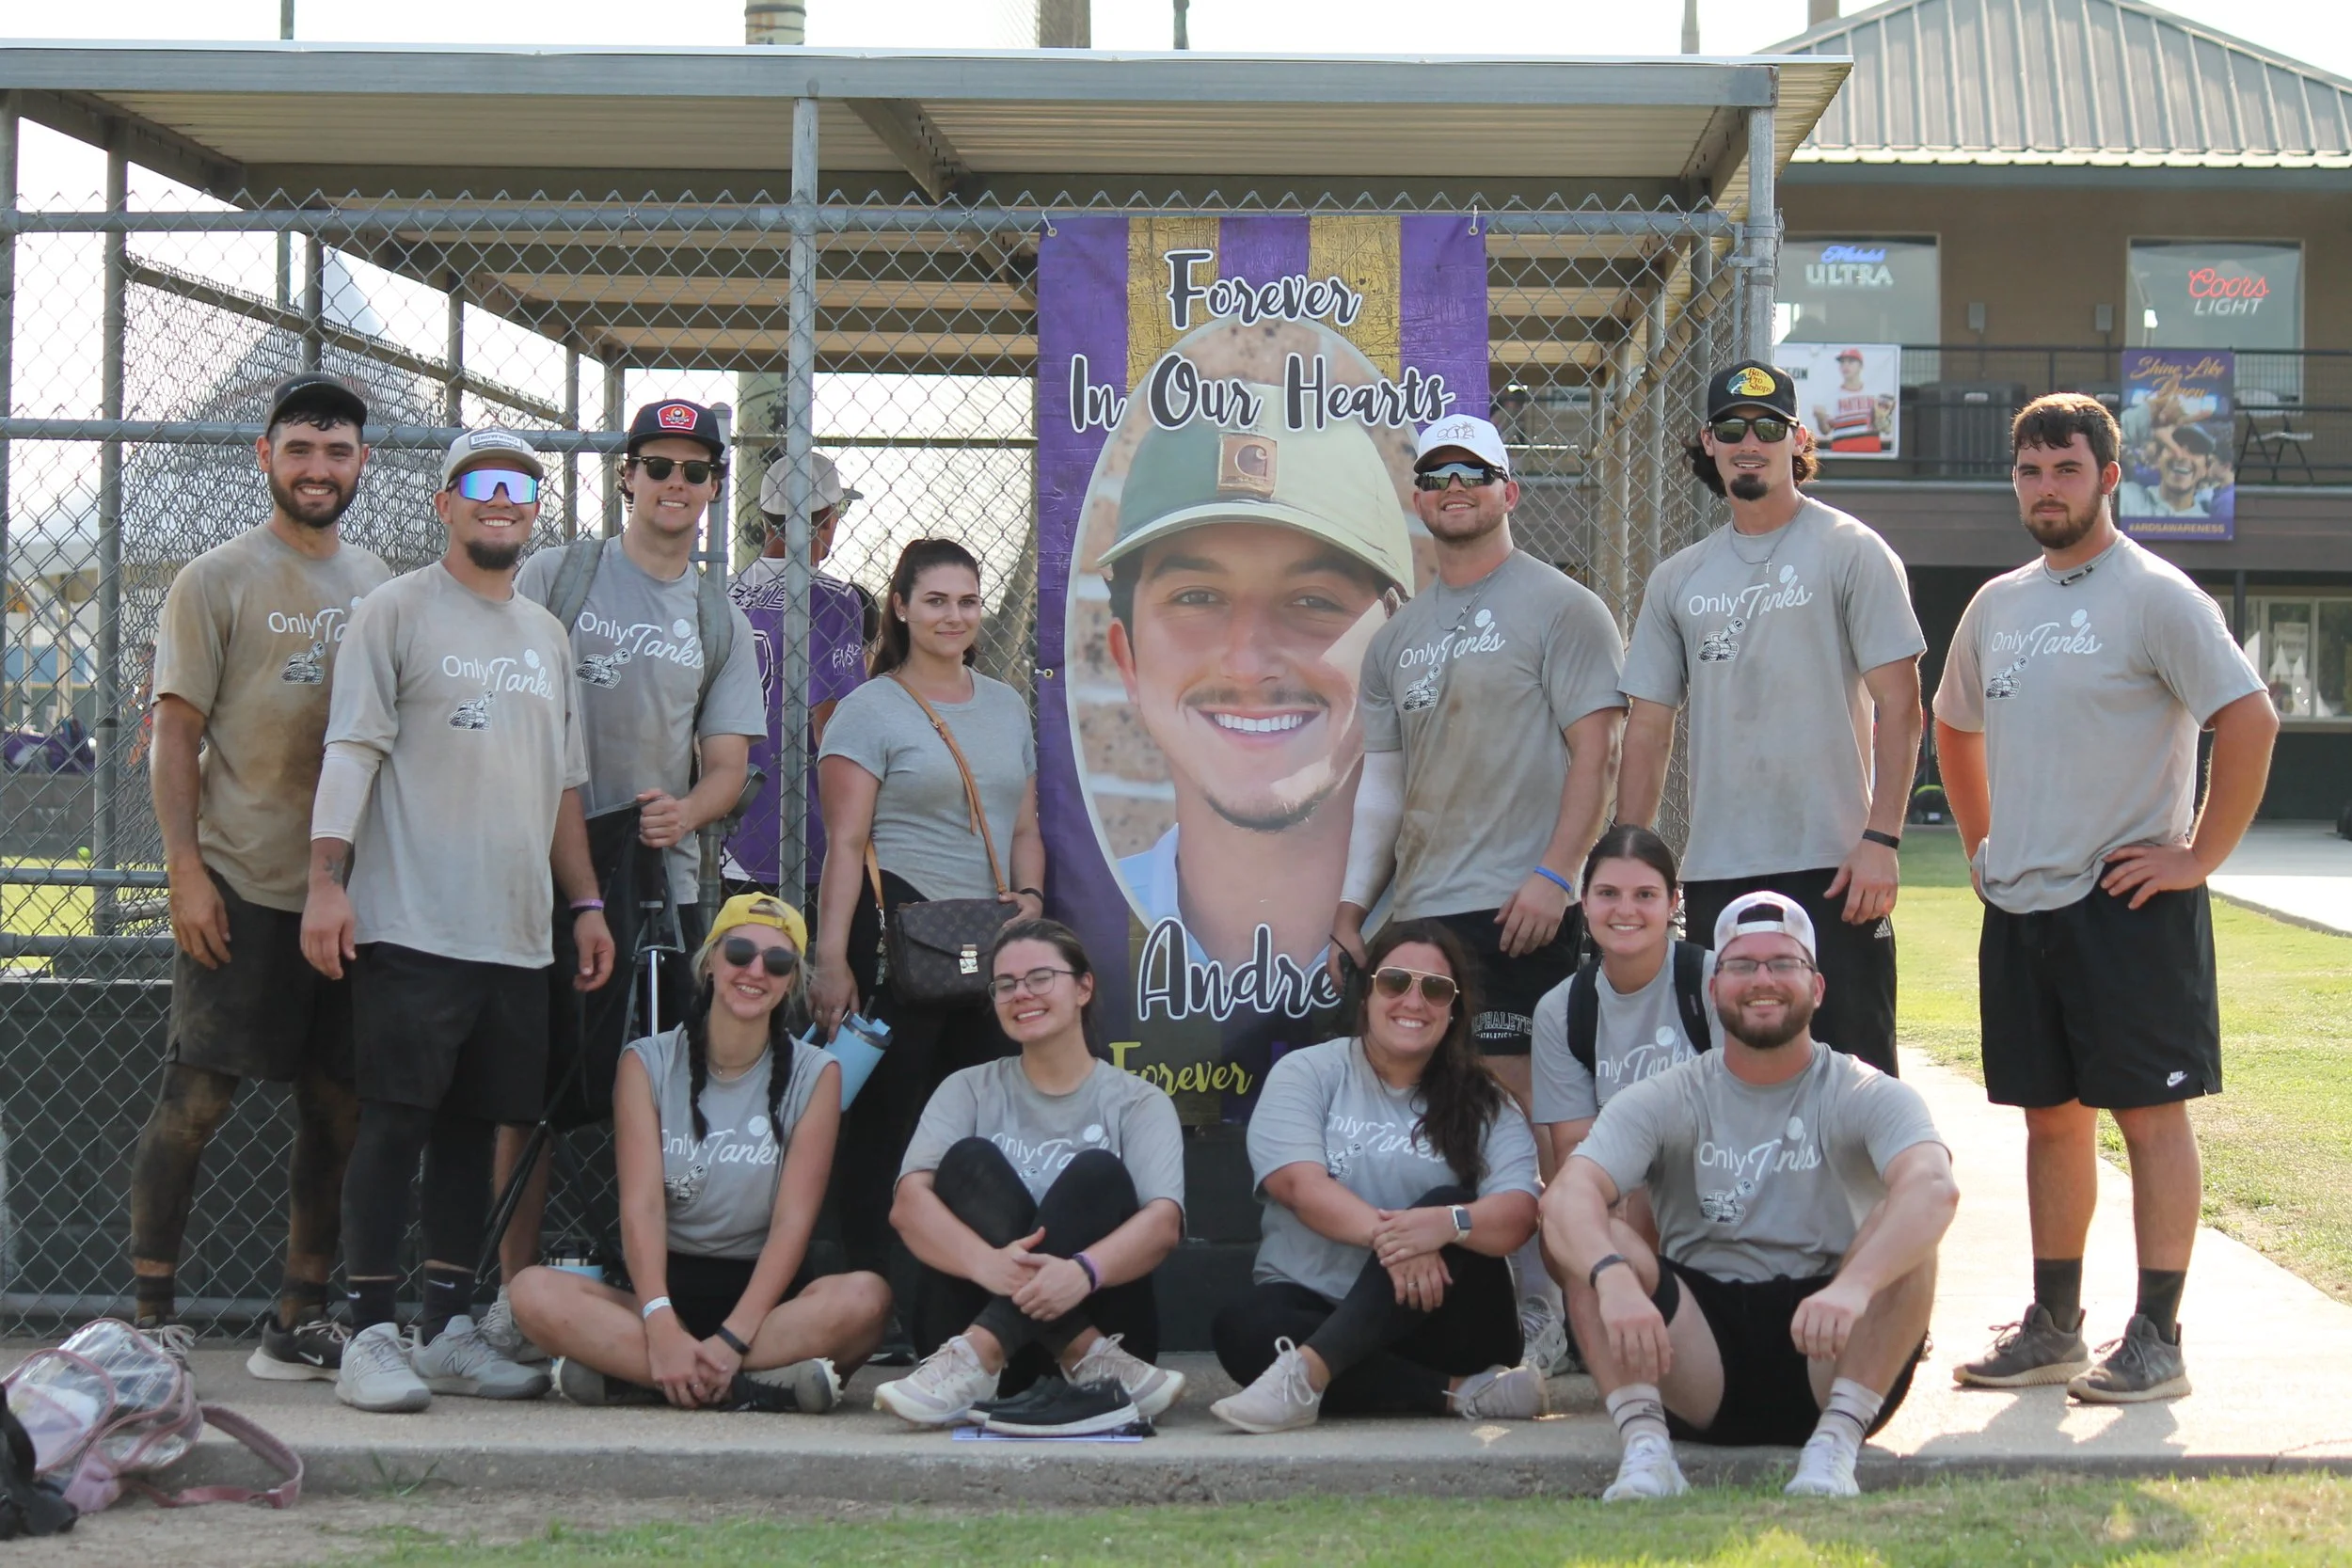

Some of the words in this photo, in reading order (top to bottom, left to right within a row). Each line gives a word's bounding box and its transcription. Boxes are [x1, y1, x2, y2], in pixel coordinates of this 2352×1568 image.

[1805, 263, 1894, 286] ULTRA
[2188, 268, 2267, 297] Coors
[1164, 248, 1362, 330] Forever
[2194, 297, 2264, 315] LIGHT
[1747, 376, 1763, 385] Pro
[1748, 368, 1768, 378] Bass
[1070, 353, 1127, 433] In
[1148, 352, 1261, 431] Our
[1284, 352, 1455, 432] Hearts
[1749, 383, 1772, 393] Shops
[1137, 916, 1342, 1022] Andre
